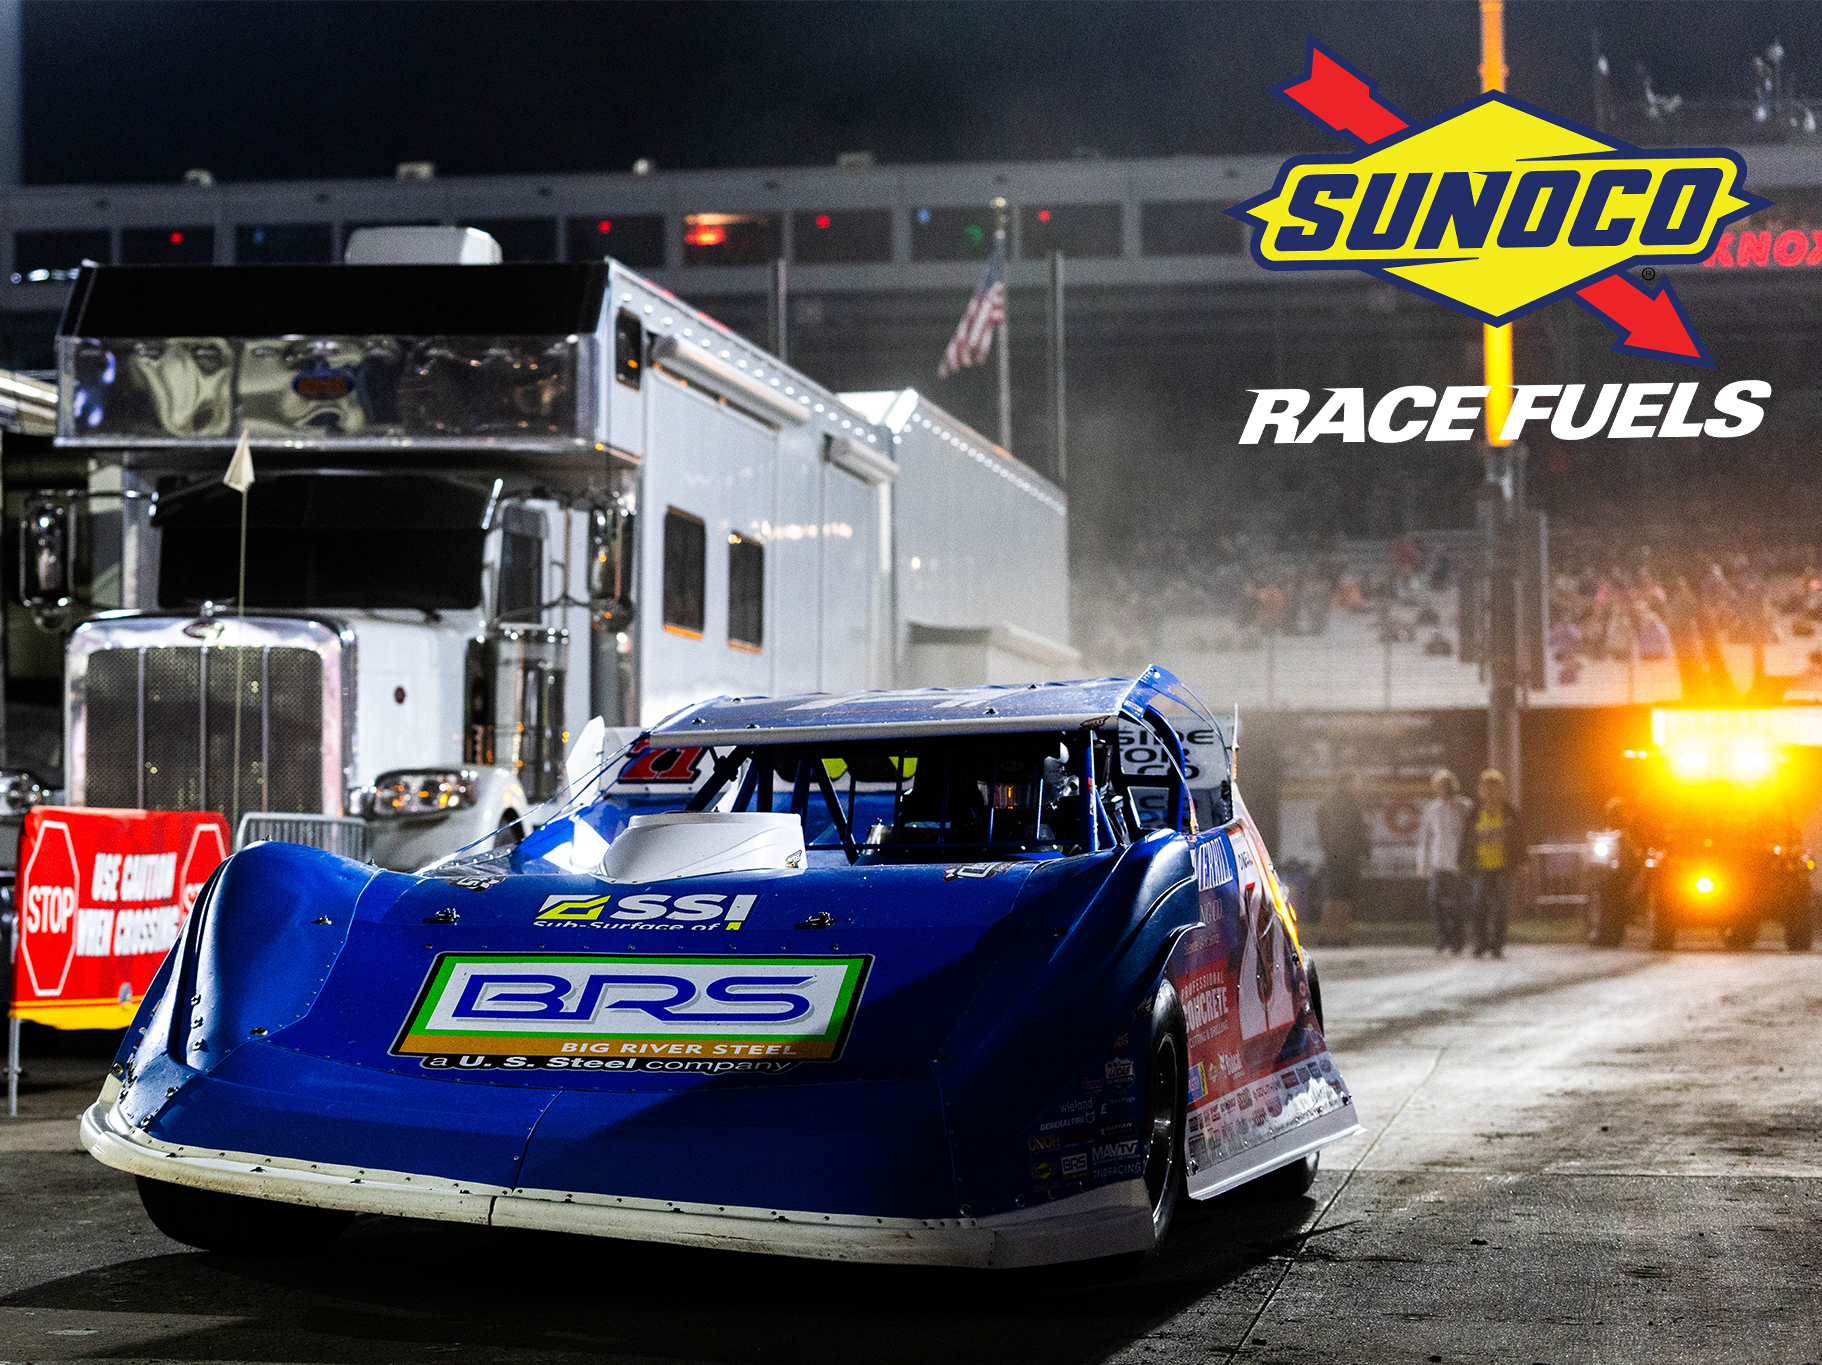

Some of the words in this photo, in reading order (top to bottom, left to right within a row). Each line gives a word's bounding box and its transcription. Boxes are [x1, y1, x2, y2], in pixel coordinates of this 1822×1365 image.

[1119, 728, 1214, 746] SIE
[92, 852, 123, 902] USE
[120, 851, 177, 902] CAUTION
[27, 884, 75, 934] STOP
[610, 894, 758, 922] SSI
[1181, 970, 1224, 1003] PROFESSIONAL
[451, 973, 819, 1026] BRS
[1182, 986, 1229, 1034] CONCRETE
[561, 1042, 610, 1053] BIG
[620, 1043, 703, 1055] RIVER
[712, 1044, 798, 1056] STEEL
[430, 1056, 448, 1067] a
[459, 1055, 493, 1067] U.
[503, 1056, 535, 1068] S.
[546, 1056, 637, 1069] Steel
[645, 1058, 792, 1073] company
[1059, 1096, 1093, 1114] wieland
[1040, 1118, 1071, 1131] GENERAL
[1071, 1115, 1086, 1125] TIRE
[1027, 1133, 1060, 1152] UNOH
[1092, 1139, 1139, 1162] MAVTV
[1062, 1156, 1087, 1171] BRS
